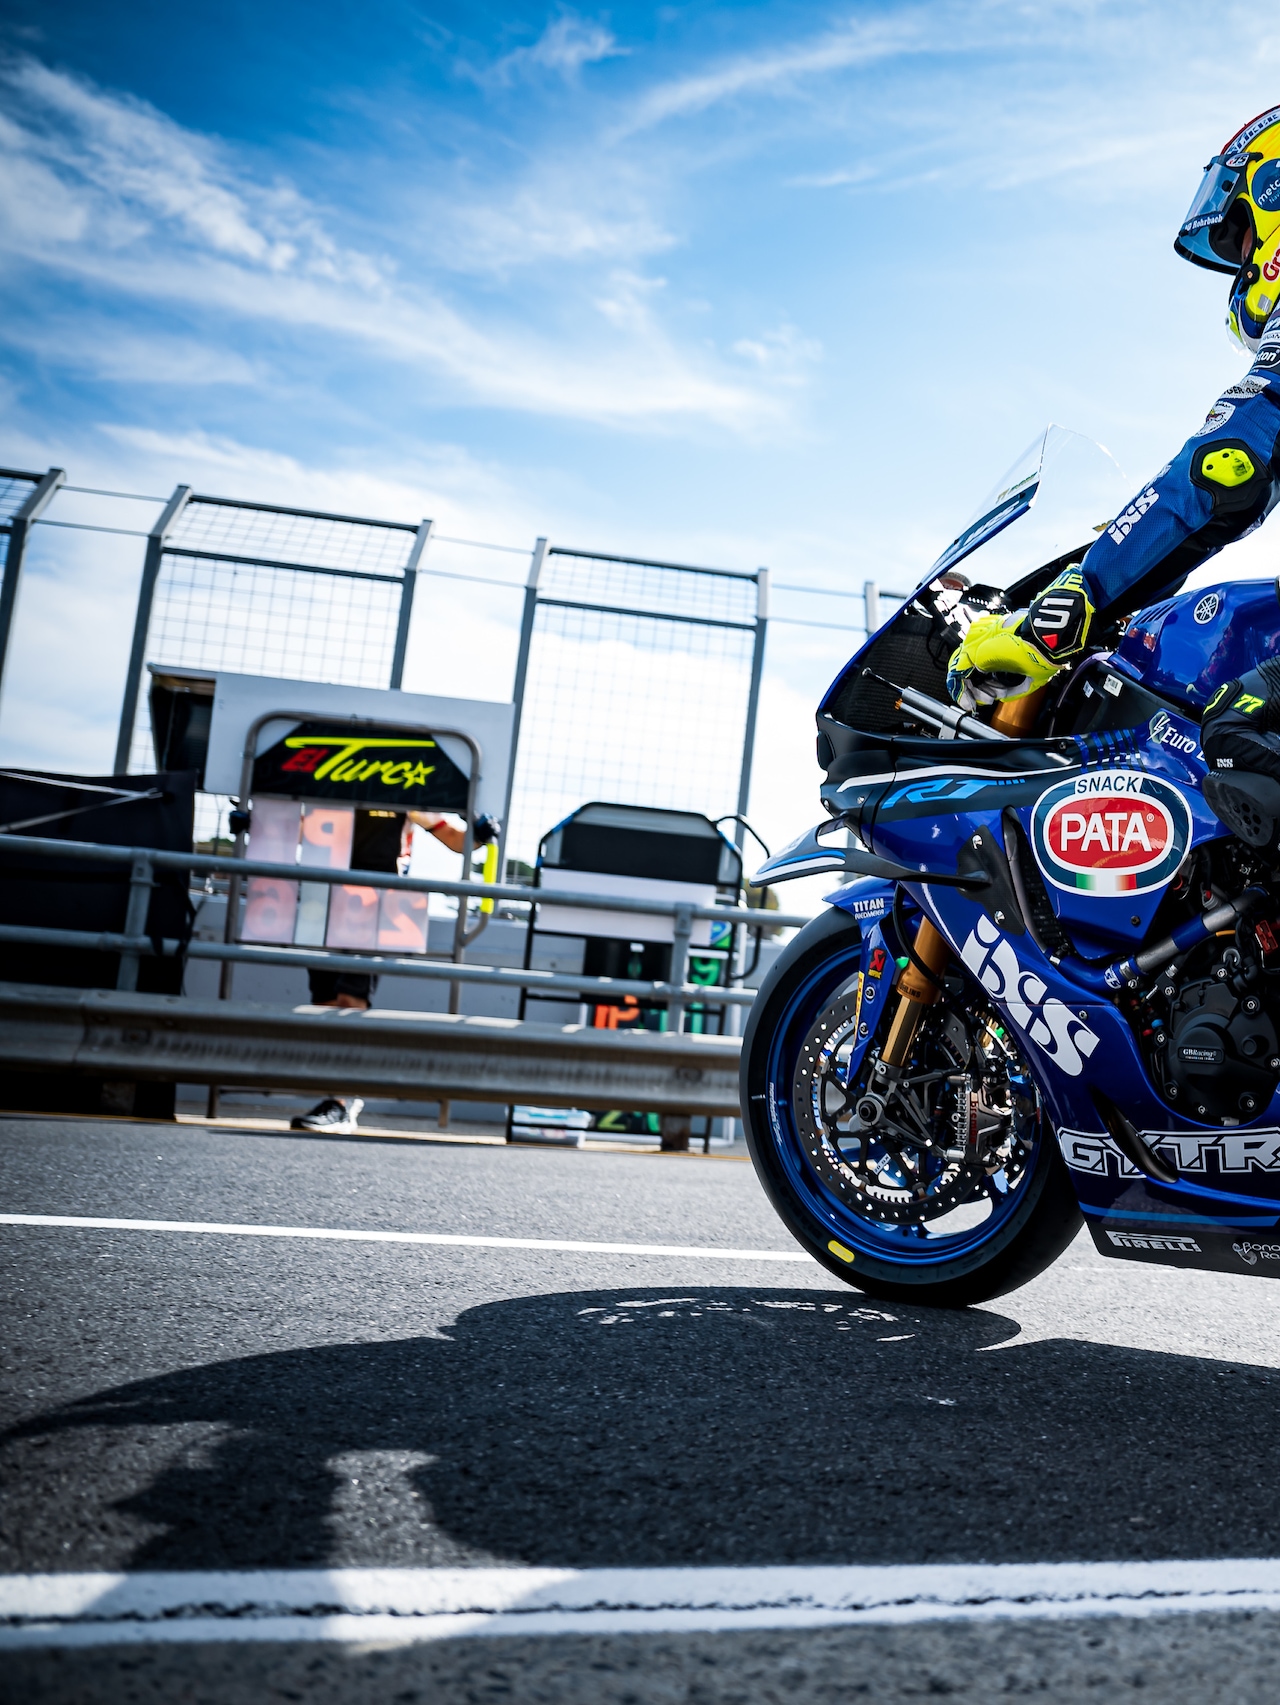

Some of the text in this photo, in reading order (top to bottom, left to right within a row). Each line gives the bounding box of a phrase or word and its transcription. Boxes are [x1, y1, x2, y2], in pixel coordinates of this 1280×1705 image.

[1233, 693, 1265, 714] 77
[1161, 725, 1197, 754] Euro
[1076, 775, 1141, 793] SNACK
[1060, 812, 1152, 852] PATA
[853, 898, 884, 913] TITAN
[1105, 1230, 1202, 1252] PIRELLI
